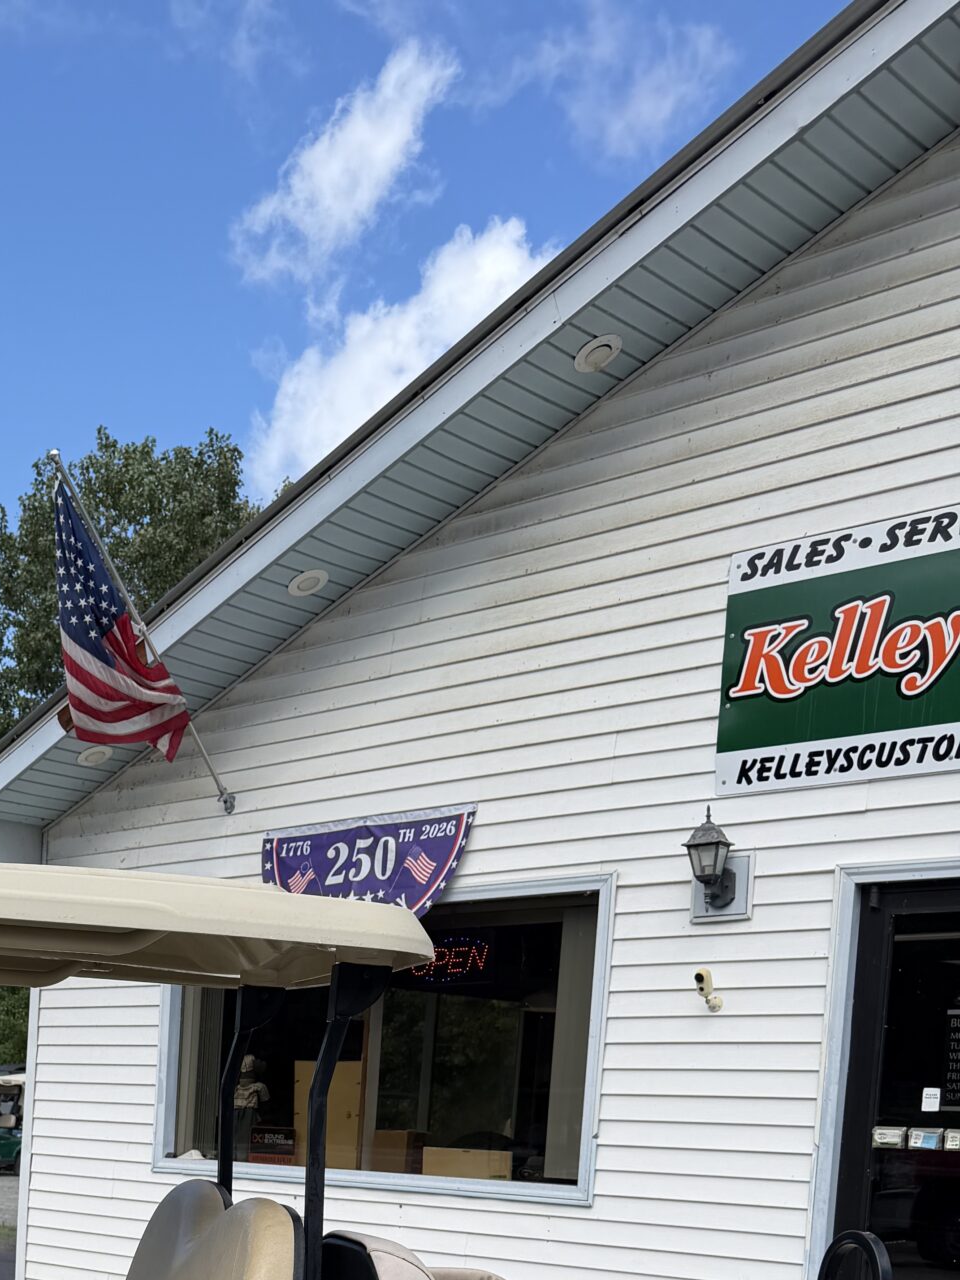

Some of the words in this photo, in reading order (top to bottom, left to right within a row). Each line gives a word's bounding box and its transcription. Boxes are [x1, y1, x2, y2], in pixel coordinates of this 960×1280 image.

[740, 533, 853, 582] SALES
[878, 511, 960, 553] SER
[736, 733, 960, 786] KELLEYSCUSTO
[279, 841, 311, 858] 1776
[420, 820, 456, 840] 2026
